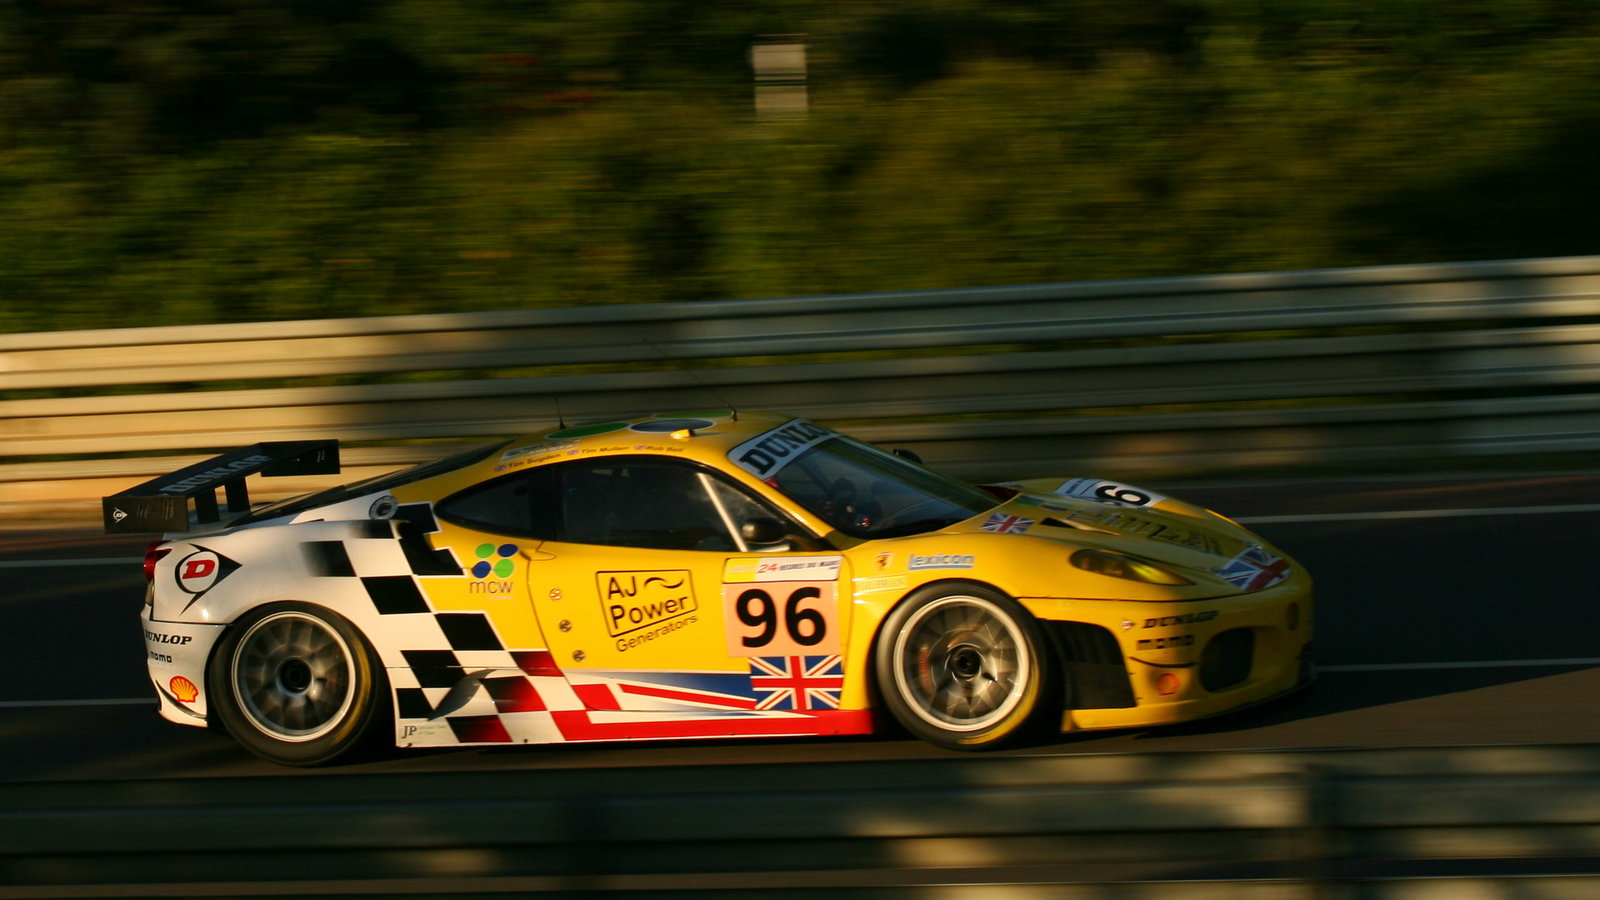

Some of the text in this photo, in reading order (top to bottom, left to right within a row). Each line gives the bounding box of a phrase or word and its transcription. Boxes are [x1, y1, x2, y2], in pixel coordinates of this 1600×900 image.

[182, 559, 215, 579] D
[757, 563, 778, 574] 24
[908, 553, 974, 567] lexicon
[469, 581, 513, 594] mcw
[608, 576, 637, 600] AJ
[610, 596, 688, 630] Power
[736, 586, 827, 648] 96
[1142, 610, 1219, 629] DUNLOP
[615, 615, 698, 652] Generators
[401, 725, 417, 739] JP
